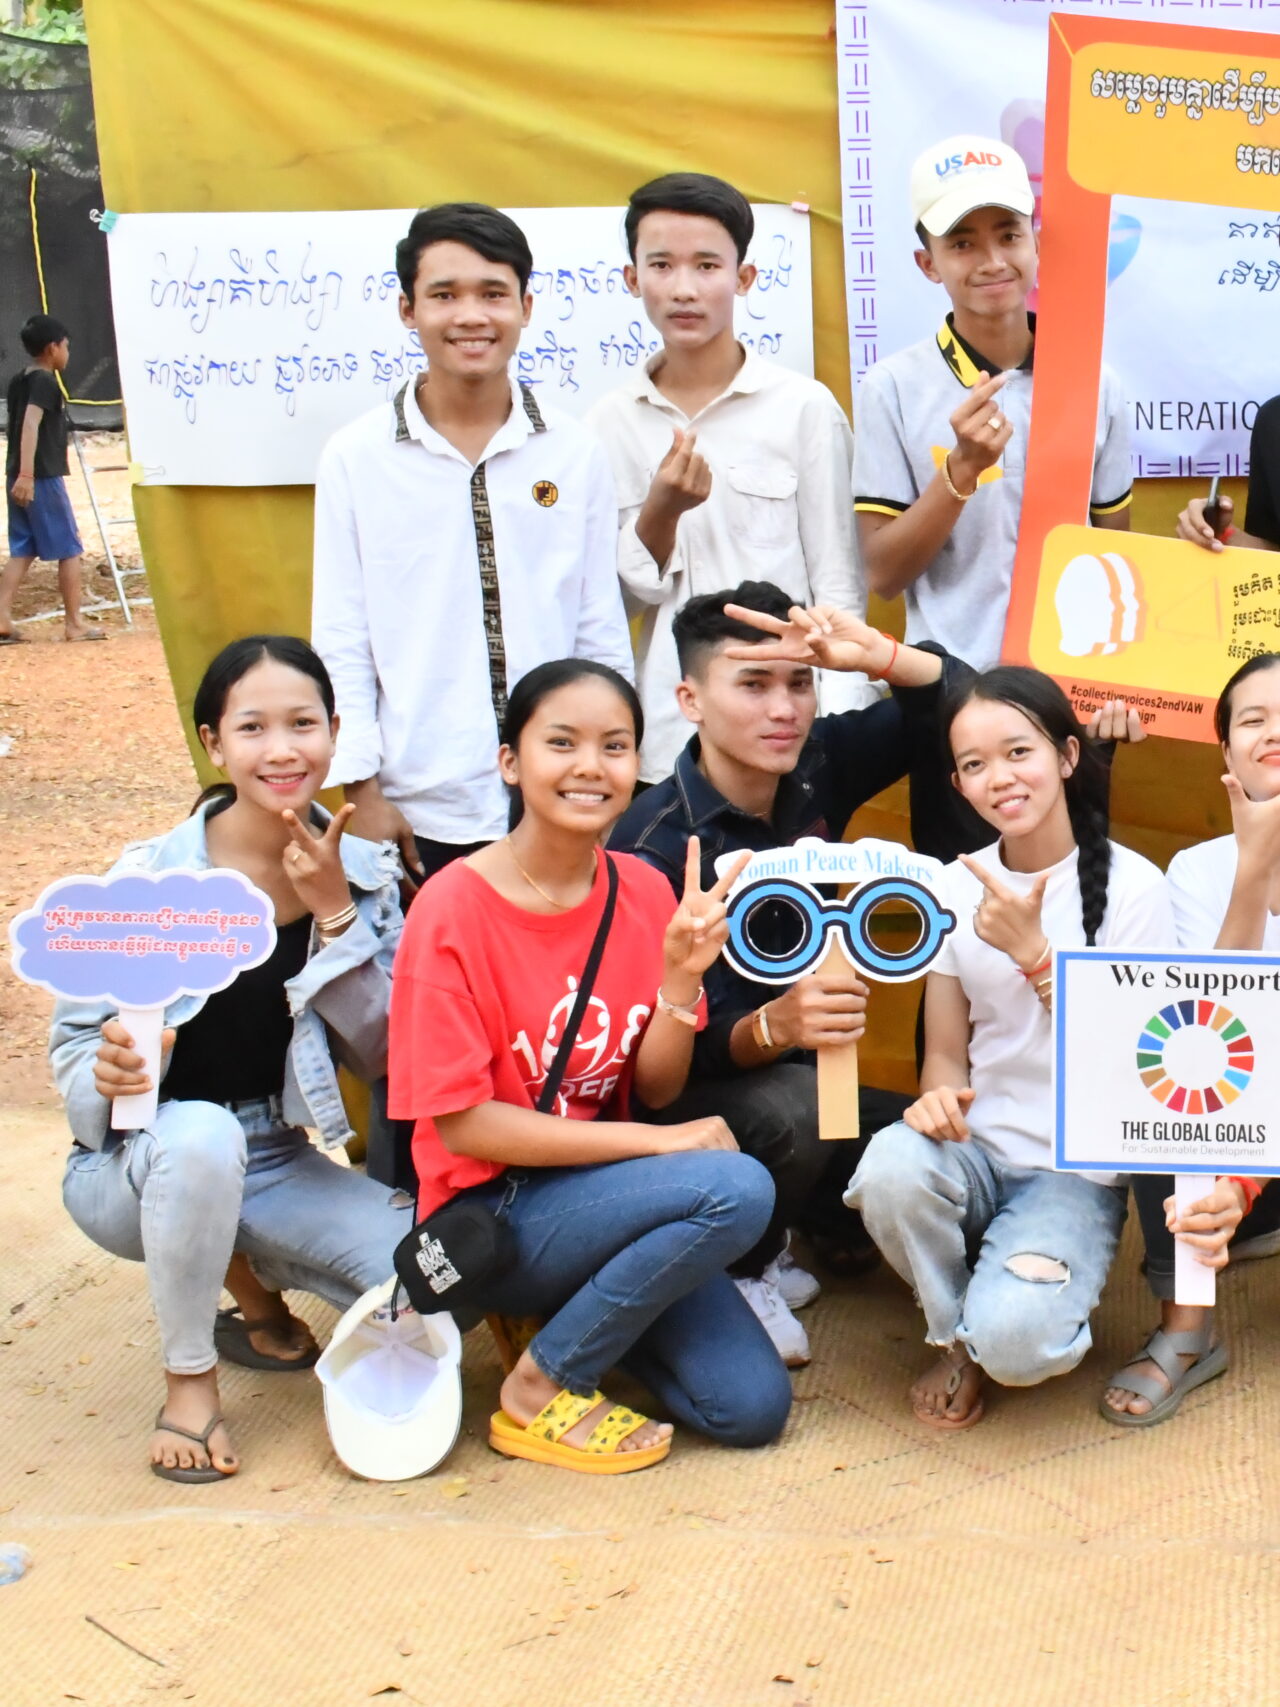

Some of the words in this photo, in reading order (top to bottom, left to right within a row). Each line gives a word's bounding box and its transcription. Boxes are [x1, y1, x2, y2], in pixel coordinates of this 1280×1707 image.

[935, 151, 1002, 176] USAID
[1132, 400, 1260, 431] NERATIO
[729, 857, 799, 881] oman
[806, 850, 858, 872] Peace
[864, 850, 934, 882] Makers
[1110, 964, 1155, 987] We
[1121, 1121, 1149, 1140] THE
[1153, 1122, 1212, 1142] GLOBAL
[1215, 1123, 1266, 1143] GOALS
[1122, 1143, 1138, 1153] For
[1141, 1144, 1198, 1155] Sustainable
[1200, 1145, 1265, 1158] Development
